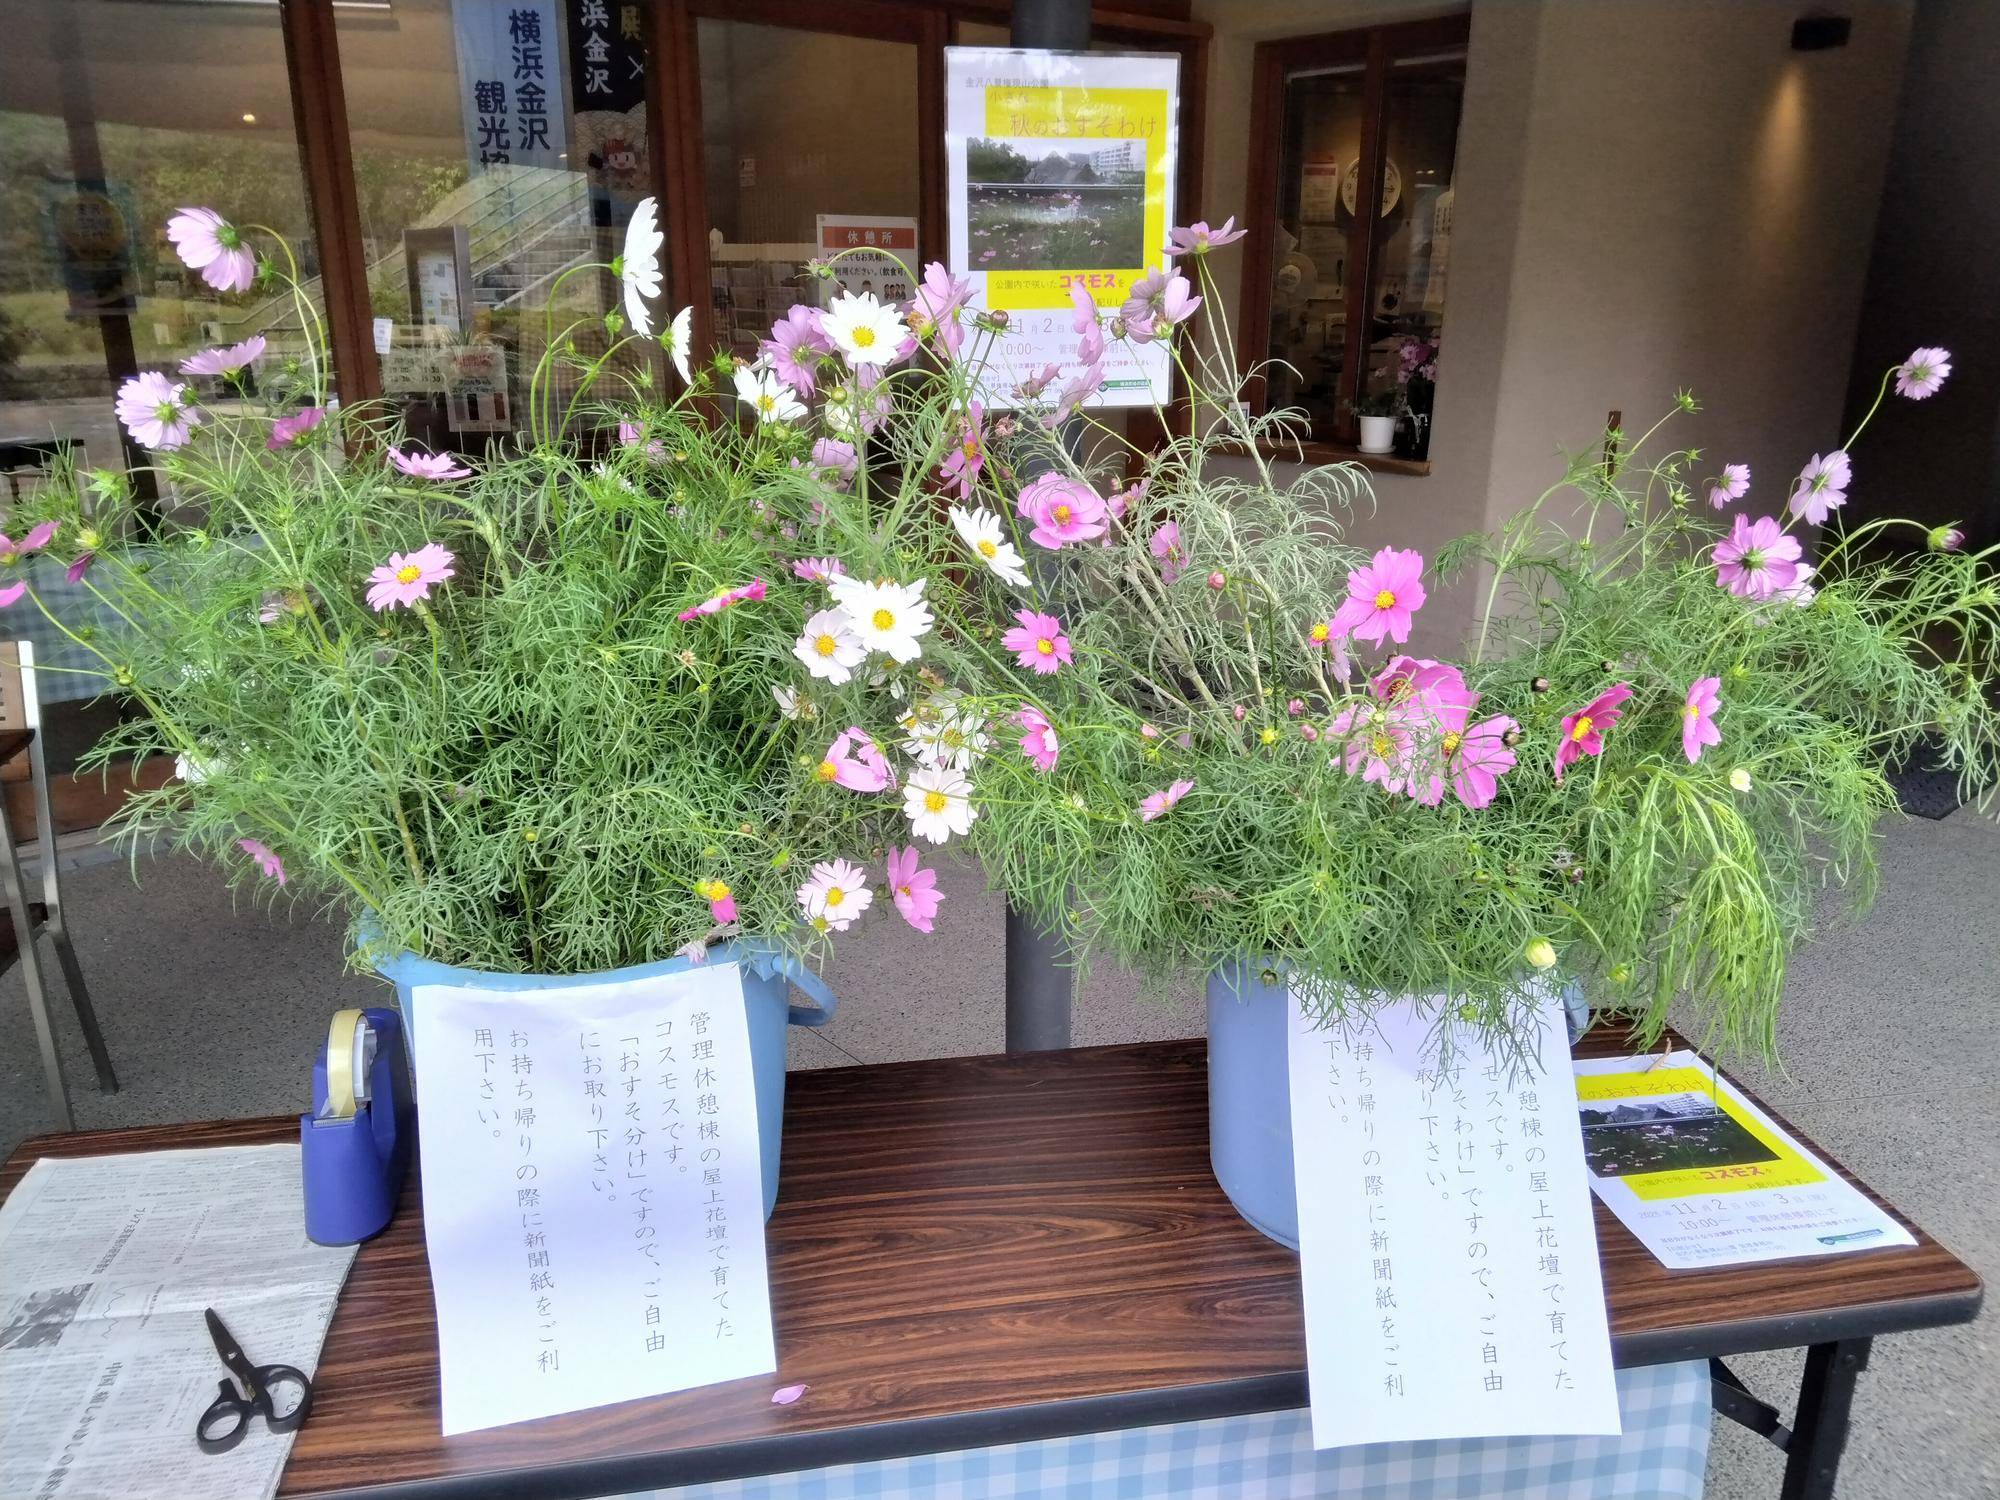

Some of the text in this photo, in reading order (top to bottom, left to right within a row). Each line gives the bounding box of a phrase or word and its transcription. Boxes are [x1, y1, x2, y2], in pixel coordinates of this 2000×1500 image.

[508, 9, 551, 151] 横浜金沢
[580, 0, 614, 94] 浜金沢
[1010, 114, 1157, 137] 秋のおすそわけ
[847, 230, 893, 245] 休憩所
[474, 1028, 501, 1138] 用下さい。
[580, 1032, 616, 1202] にお取り下さい。
[655, 1019, 687, 1173] コスモスです。
[1577, 1079, 1705, 1099] のおすそわけ
[510, 1029, 559, 1374] お持ち帰りの際に新聞紙をご利
[619, 1036, 666, 1354] 「おすそ分け」ですので、ご自由
[690, 1012, 735, 1340] 管理休憩棟の屋上花壇で育てた
